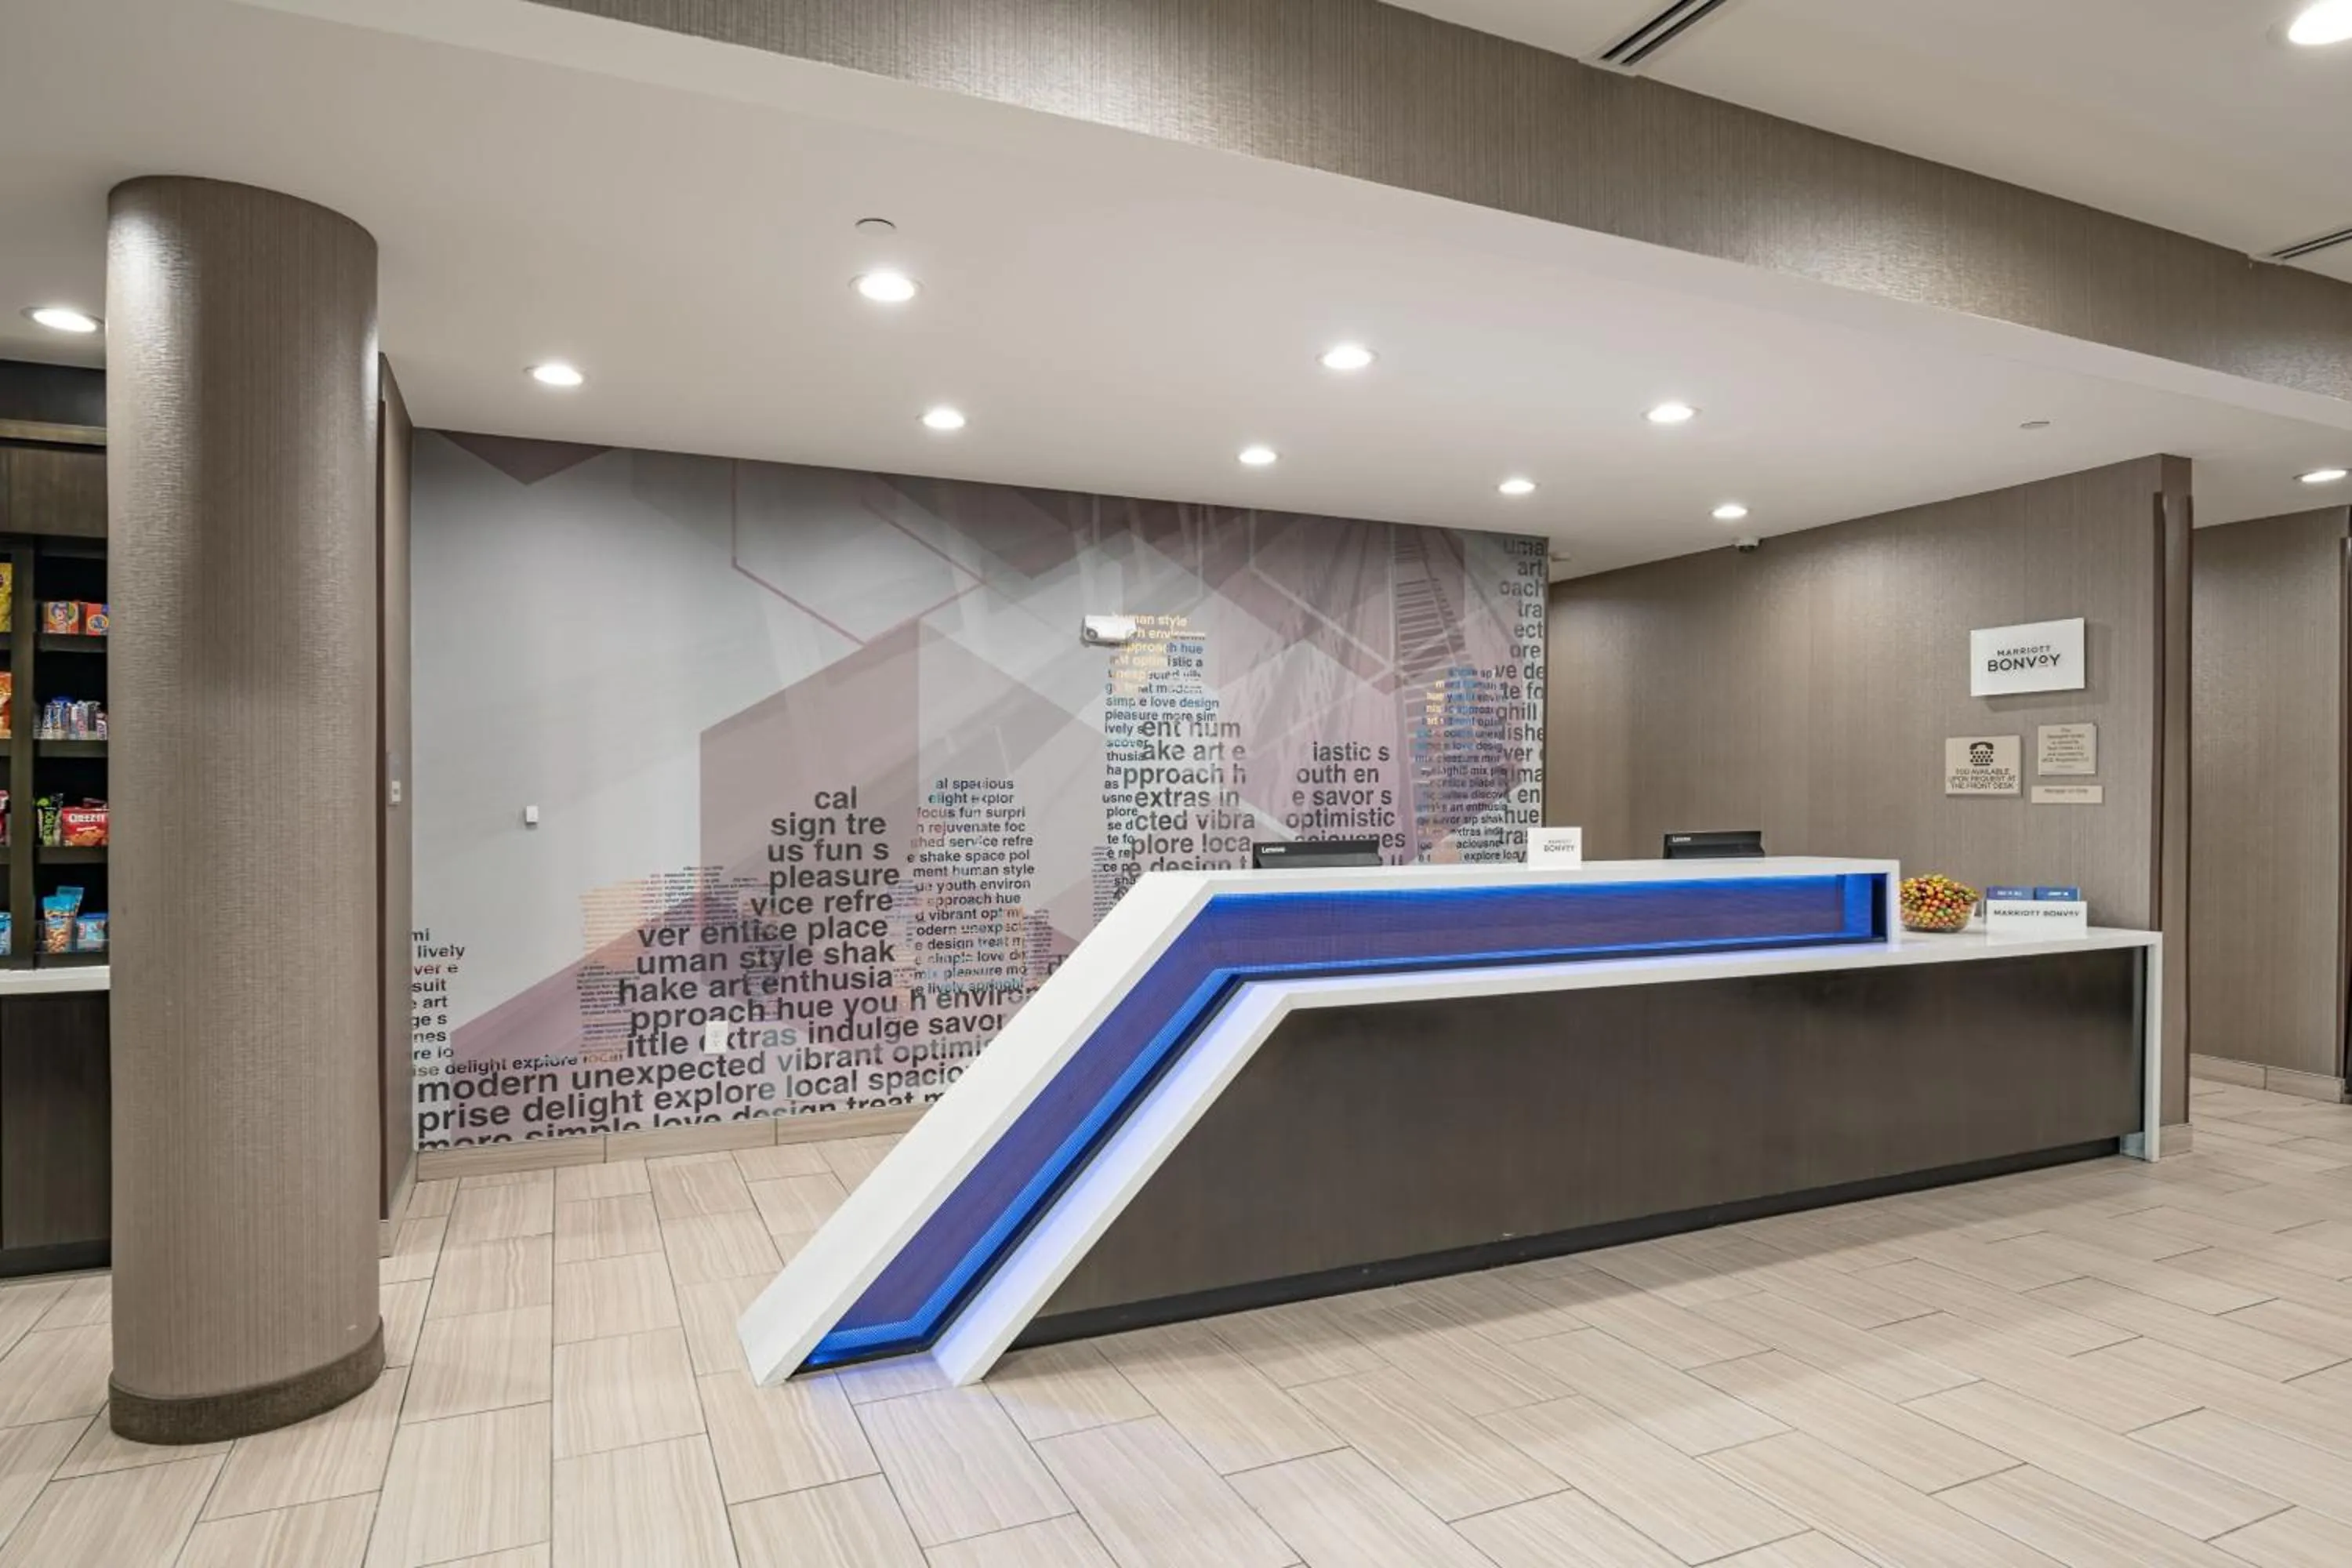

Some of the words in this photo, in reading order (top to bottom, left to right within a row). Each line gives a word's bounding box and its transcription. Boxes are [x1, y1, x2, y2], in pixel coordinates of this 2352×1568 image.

[1517, 559, 1543, 577] art
[1518, 599, 1542, 618] tra
[1514, 621, 1543, 639] ect
[1181, 642, 1203, 654] hue
[1510, 644, 1541, 659] ore
[1997, 644, 2051, 657] MARRIOTT
[1987, 653, 2061, 672] BONVOY
[1105, 695, 1147, 708] simpe
[1150, 696, 1176, 706] love
[1179, 697, 1219, 711] design
[1105, 710, 1158, 723] pleasure
[1143, 740, 1185, 761] ake
[1192, 742, 1224, 761] art
[1232, 745, 1246, 761] e
[1313, 741, 1371, 761] iastic
[1378, 745, 1391, 761] s
[1106, 764, 1122, 775] ha
[1123, 763, 1224, 789] pproach
[1233, 763, 1246, 783] h
[1296, 763, 1346, 784] outh
[1353, 768, 1379, 783] en
[1104, 780, 1120, 789] as
[815, 786, 857, 809] cal
[1134, 787, 1210, 808] extras
[1219, 789, 1240, 807] in
[1292, 790, 1305, 806] e
[1312, 789, 1374, 807] savor
[1381, 789, 1392, 806] s
[1517, 787, 1541, 804] en
[916, 807, 955, 818] focus
[960, 806, 981, 818] fun
[985, 806, 1026, 820] surpri
[1106, 808, 1138, 818] plore
[1134, 810, 1188, 830] cted
[1196, 809, 1255, 830] vibra
[1286, 807, 1396, 831] optimistic
[1504, 806, 1539, 824] hue
[771, 811, 836, 842] sign
[847, 813, 887, 835] tre
[1004, 821, 1025, 832] foc
[1107, 821, 1122, 830] se
[1003, 834, 1033, 846] refre
[1107, 833, 1119, 844] te
[1499, 826, 1528, 845] tra
[768, 843, 804, 862] us
[814, 838, 862, 862] fun
[873, 841, 889, 861] s
[1131, 834, 1194, 860] plore
[1202, 833, 1251, 853] loca
[907, 853, 915, 863] e
[920, 851, 961, 863] shake
[965, 851, 1006, 864] space
[1009, 849, 1029, 863] pol
[913, 865, 948, 877] ment
[953, 865, 999, 877] human
[1003, 863, 1035, 878] style
[768, 865, 900, 895] pleasure
[937, 879, 976, 894] youth
[980, 878, 1030, 890] environ
[750, 895, 814, 916] vice
[824, 889, 893, 913] refre
[996, 891, 1022, 904] hue
[929, 908, 977, 921] vibrant
[637, 927, 690, 948] ver
[700, 920, 797, 945] entice
[808, 916, 888, 946] place
[417, 944, 466, 960] lively
[927, 937, 975, 950] design
[637, 951, 728, 975] uman
[739, 943, 814, 972] style
[824, 940, 896, 964] shak
[413, 964, 441, 976] ver
[448, 964, 459, 974] e
[412, 979, 446, 993] suit
[618, 977, 698, 1005] hake
[709, 974, 752, 998] art
[761, 966, 892, 994] enthusia
[423, 996, 448, 1008] art
[437, 1014, 448, 1025] s
[630, 1000, 765, 1036] pproach
[777, 997, 833, 1020] hue
[843, 995, 898, 1021] you
[413, 1031, 446, 1043] nes
[699, 1026, 797, 1054] xtras
[808, 1015, 919, 1045] indulge
[413, 1047, 431, 1060] re
[417, 1069, 558, 1103] modern
[572, 1051, 766, 1091] unexpected
[777, 1042, 884, 1073] vibrant
[893, 1034, 993, 1068] optimi
[445, 1057, 507, 1076] delight
[417, 1102, 511, 1139] prise
[522, 1089, 644, 1123] delight
[654, 1080, 775, 1114] explore
[786, 1069, 857, 1098] local
